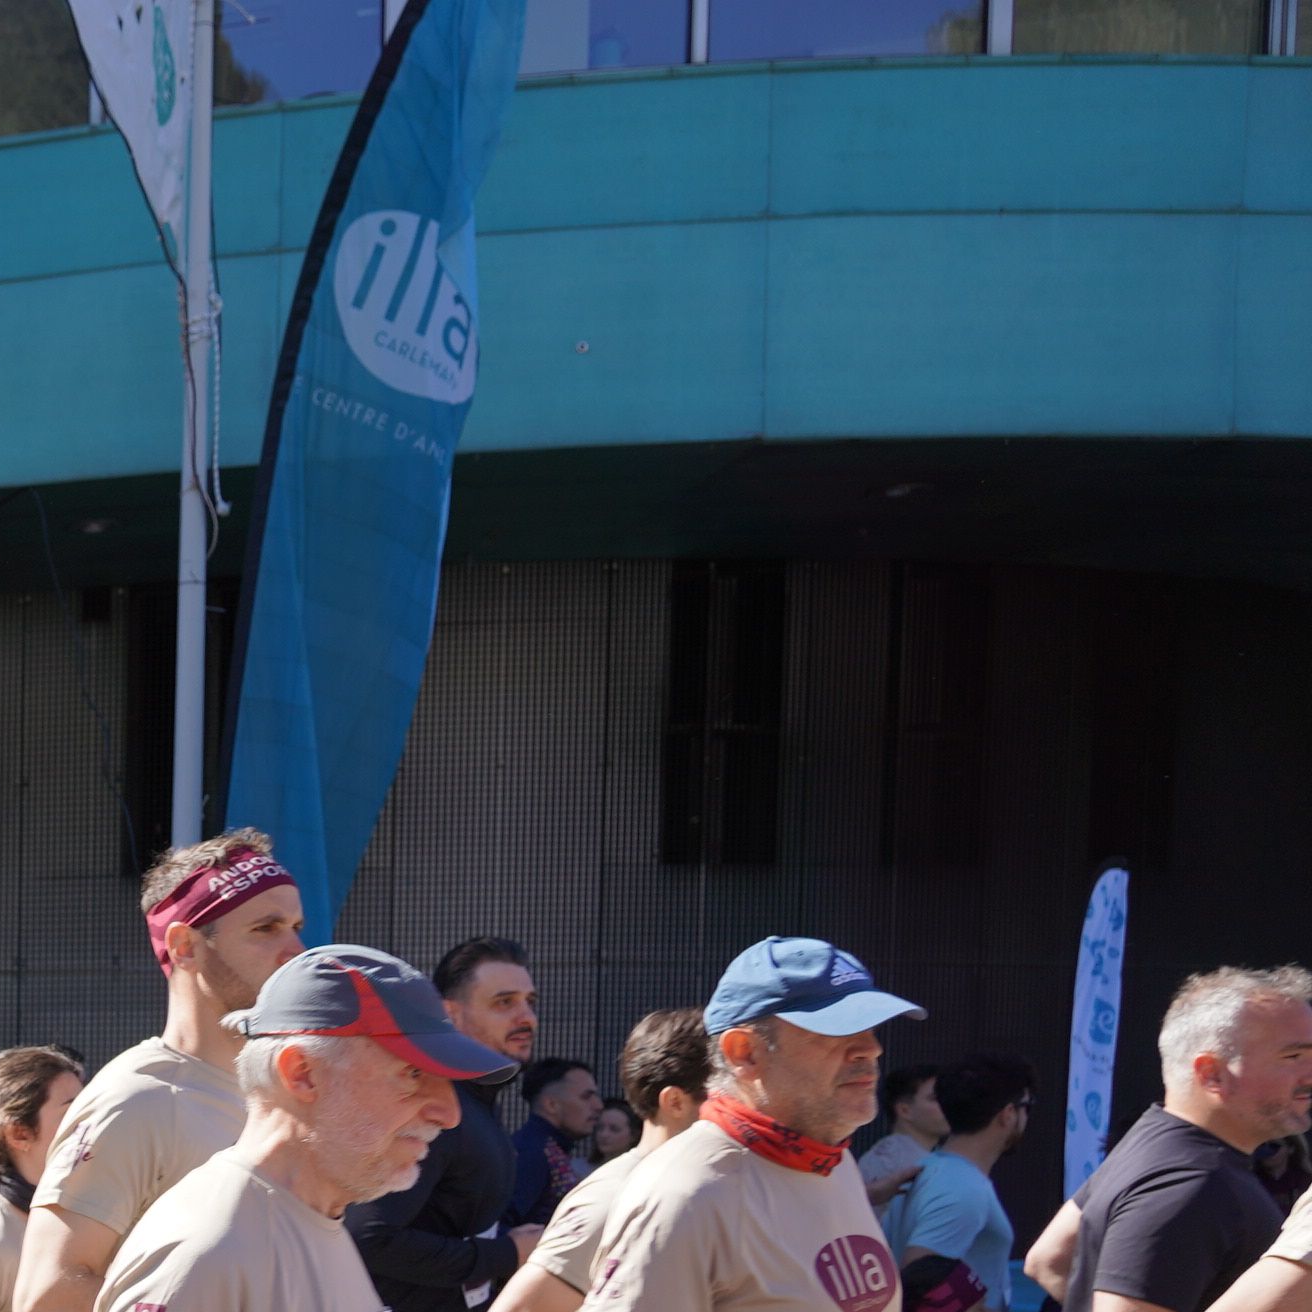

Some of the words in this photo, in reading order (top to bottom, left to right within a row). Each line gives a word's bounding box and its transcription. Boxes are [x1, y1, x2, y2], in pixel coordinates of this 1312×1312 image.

[352, 215, 472, 370] illa
[312, 387, 389, 431] CENTRE
[394, 423, 446, 465] D'AN
[821, 1237, 888, 1300] illa
